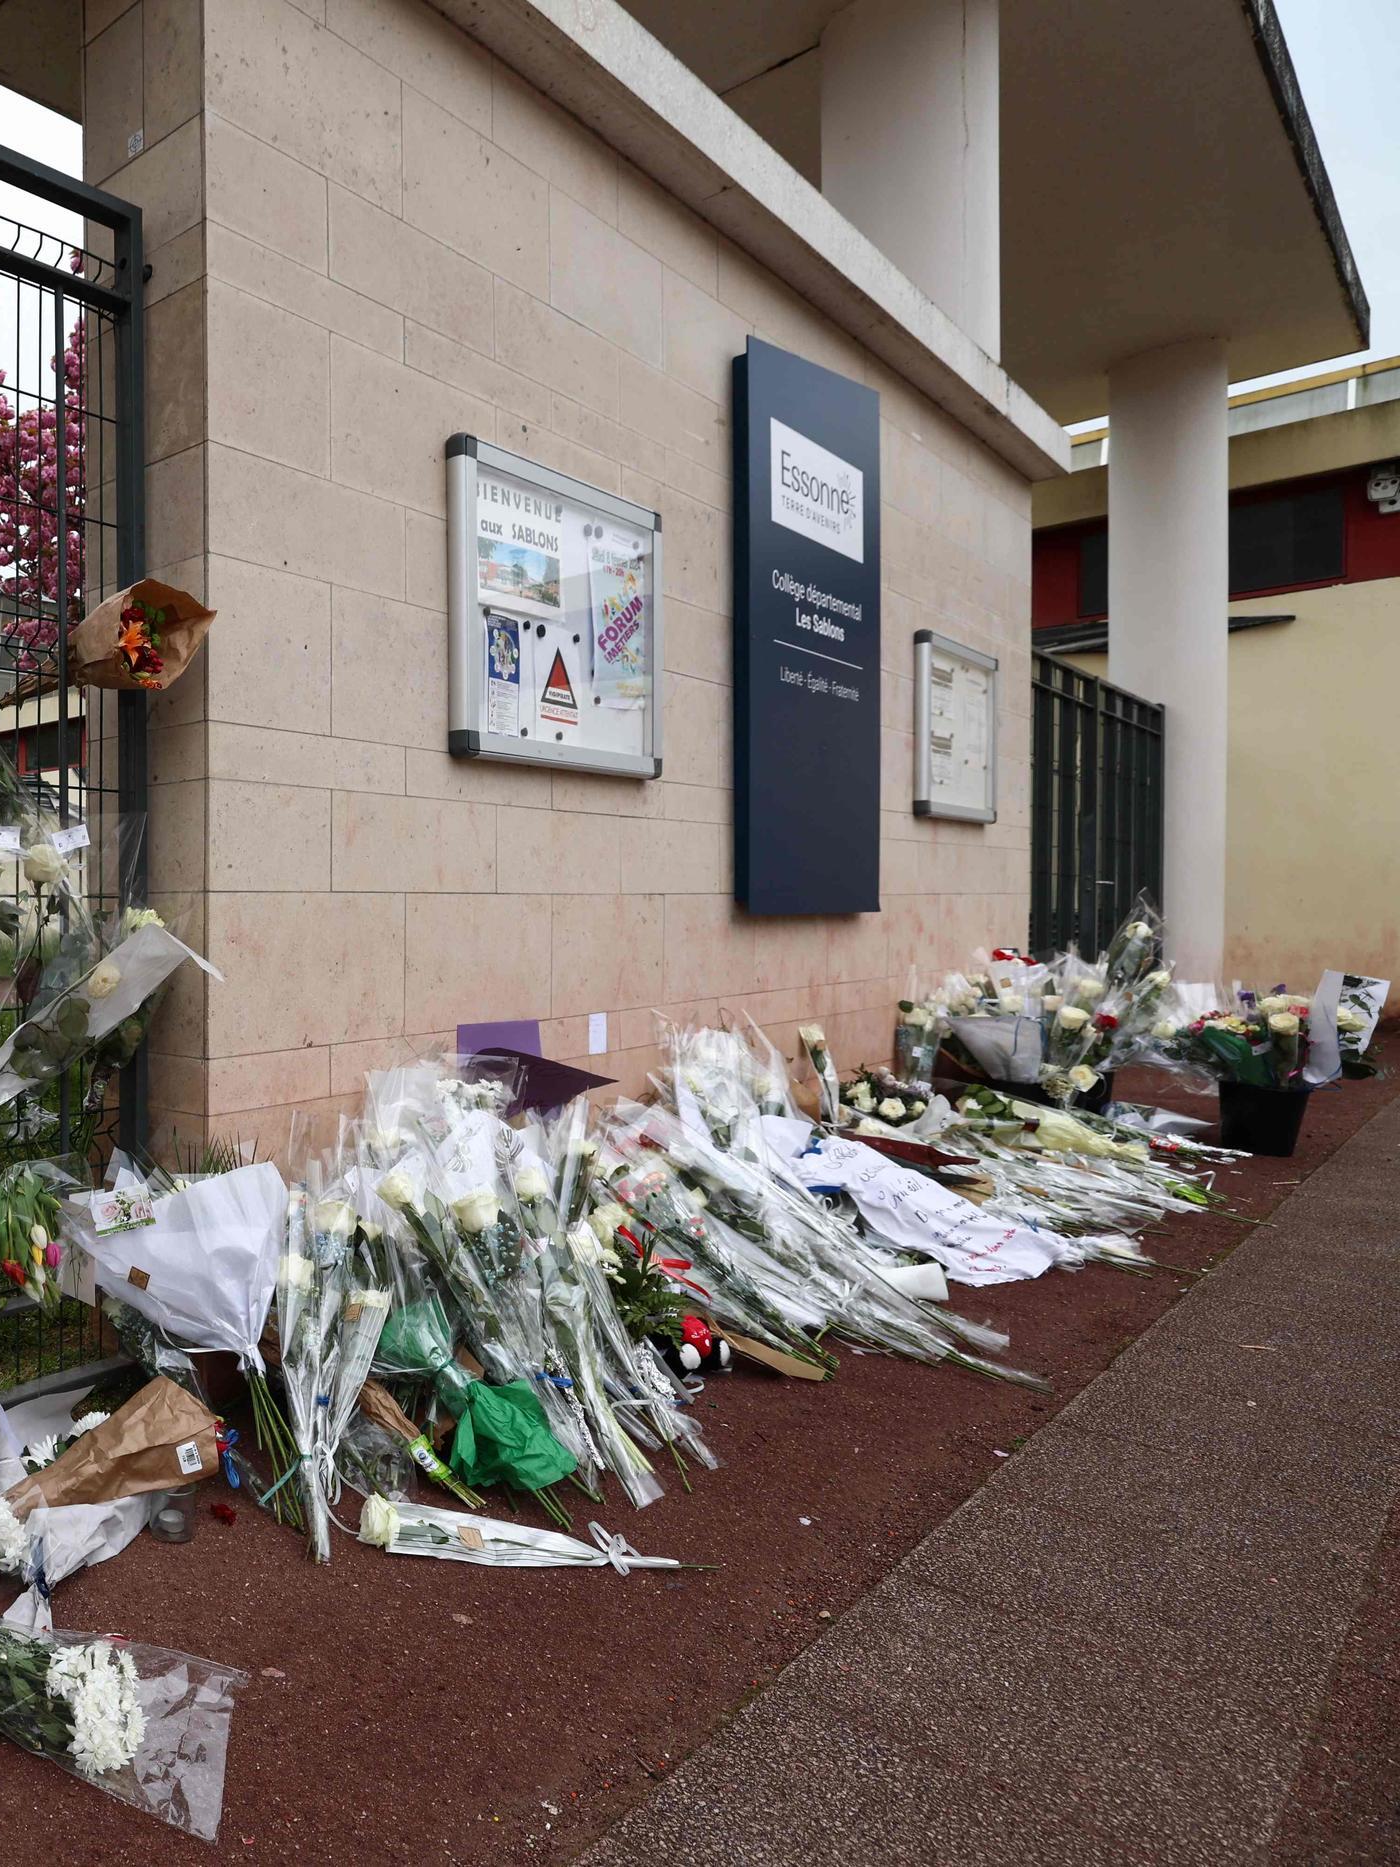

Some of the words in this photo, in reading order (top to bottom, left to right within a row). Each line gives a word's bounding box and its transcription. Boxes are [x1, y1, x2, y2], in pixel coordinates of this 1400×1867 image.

[781, 449, 850, 515] Essonne
[781, 494, 805, 517] TERRE
[481, 519, 503, 536] aux
[511, 523, 559, 553] SABLONS
[772, 569, 805, 602] Collège
[806, 583, 862, 621] départemental
[598, 595, 643, 652] FORUM
[795, 607, 812, 630] Les
[812, 614, 845, 642] Sablons
[780, 665, 803, 687] Liberté
[807, 670, 829, 693] Égalité
[831, 680, 859, 702] Fraternité
